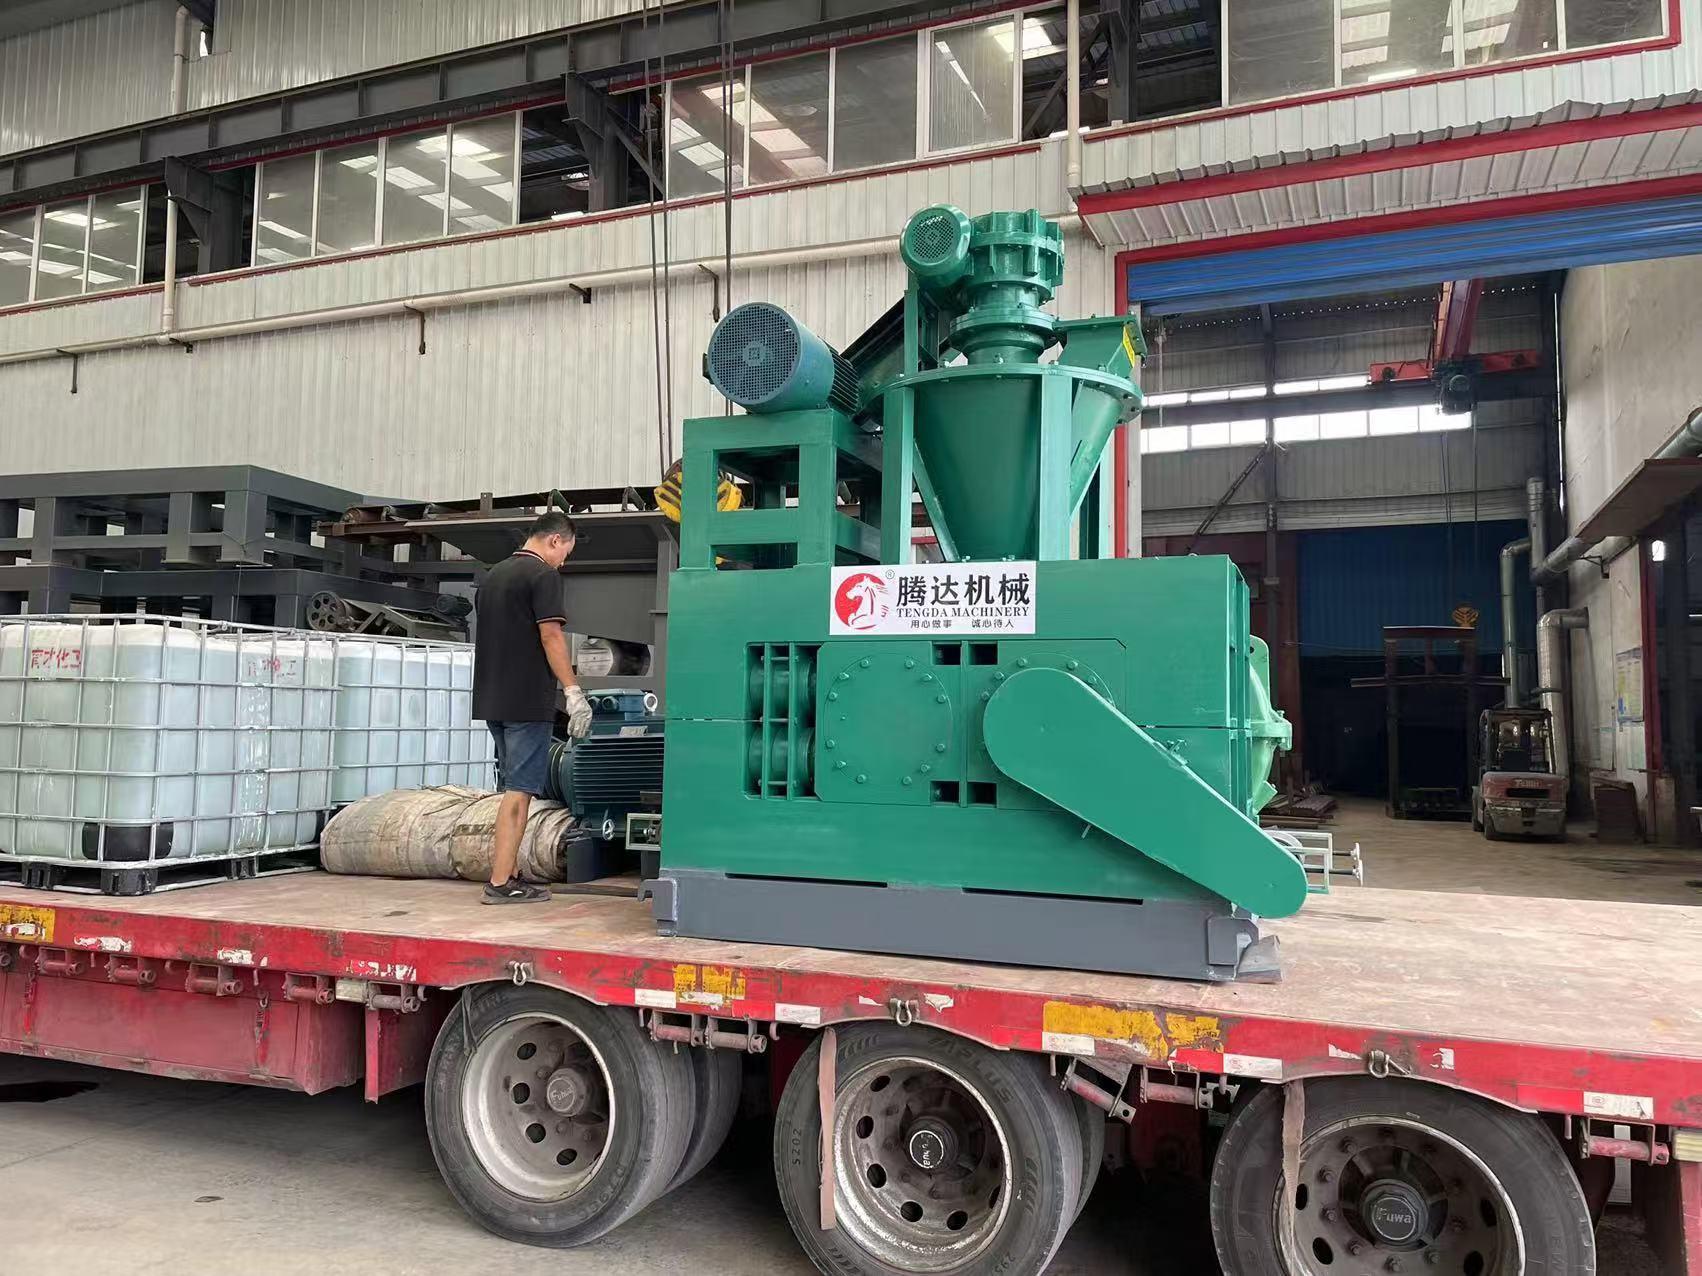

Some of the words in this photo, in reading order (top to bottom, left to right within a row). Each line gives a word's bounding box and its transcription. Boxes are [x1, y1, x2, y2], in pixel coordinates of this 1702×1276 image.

[896, 573, 1029, 607] 腾达机械
[896, 607, 948, 618] TENGDA
[952, 606, 1030, 617] MACHINERY
[910, 619, 953, 629] 用心做事
[971, 618, 1015, 629] 诚心待人
